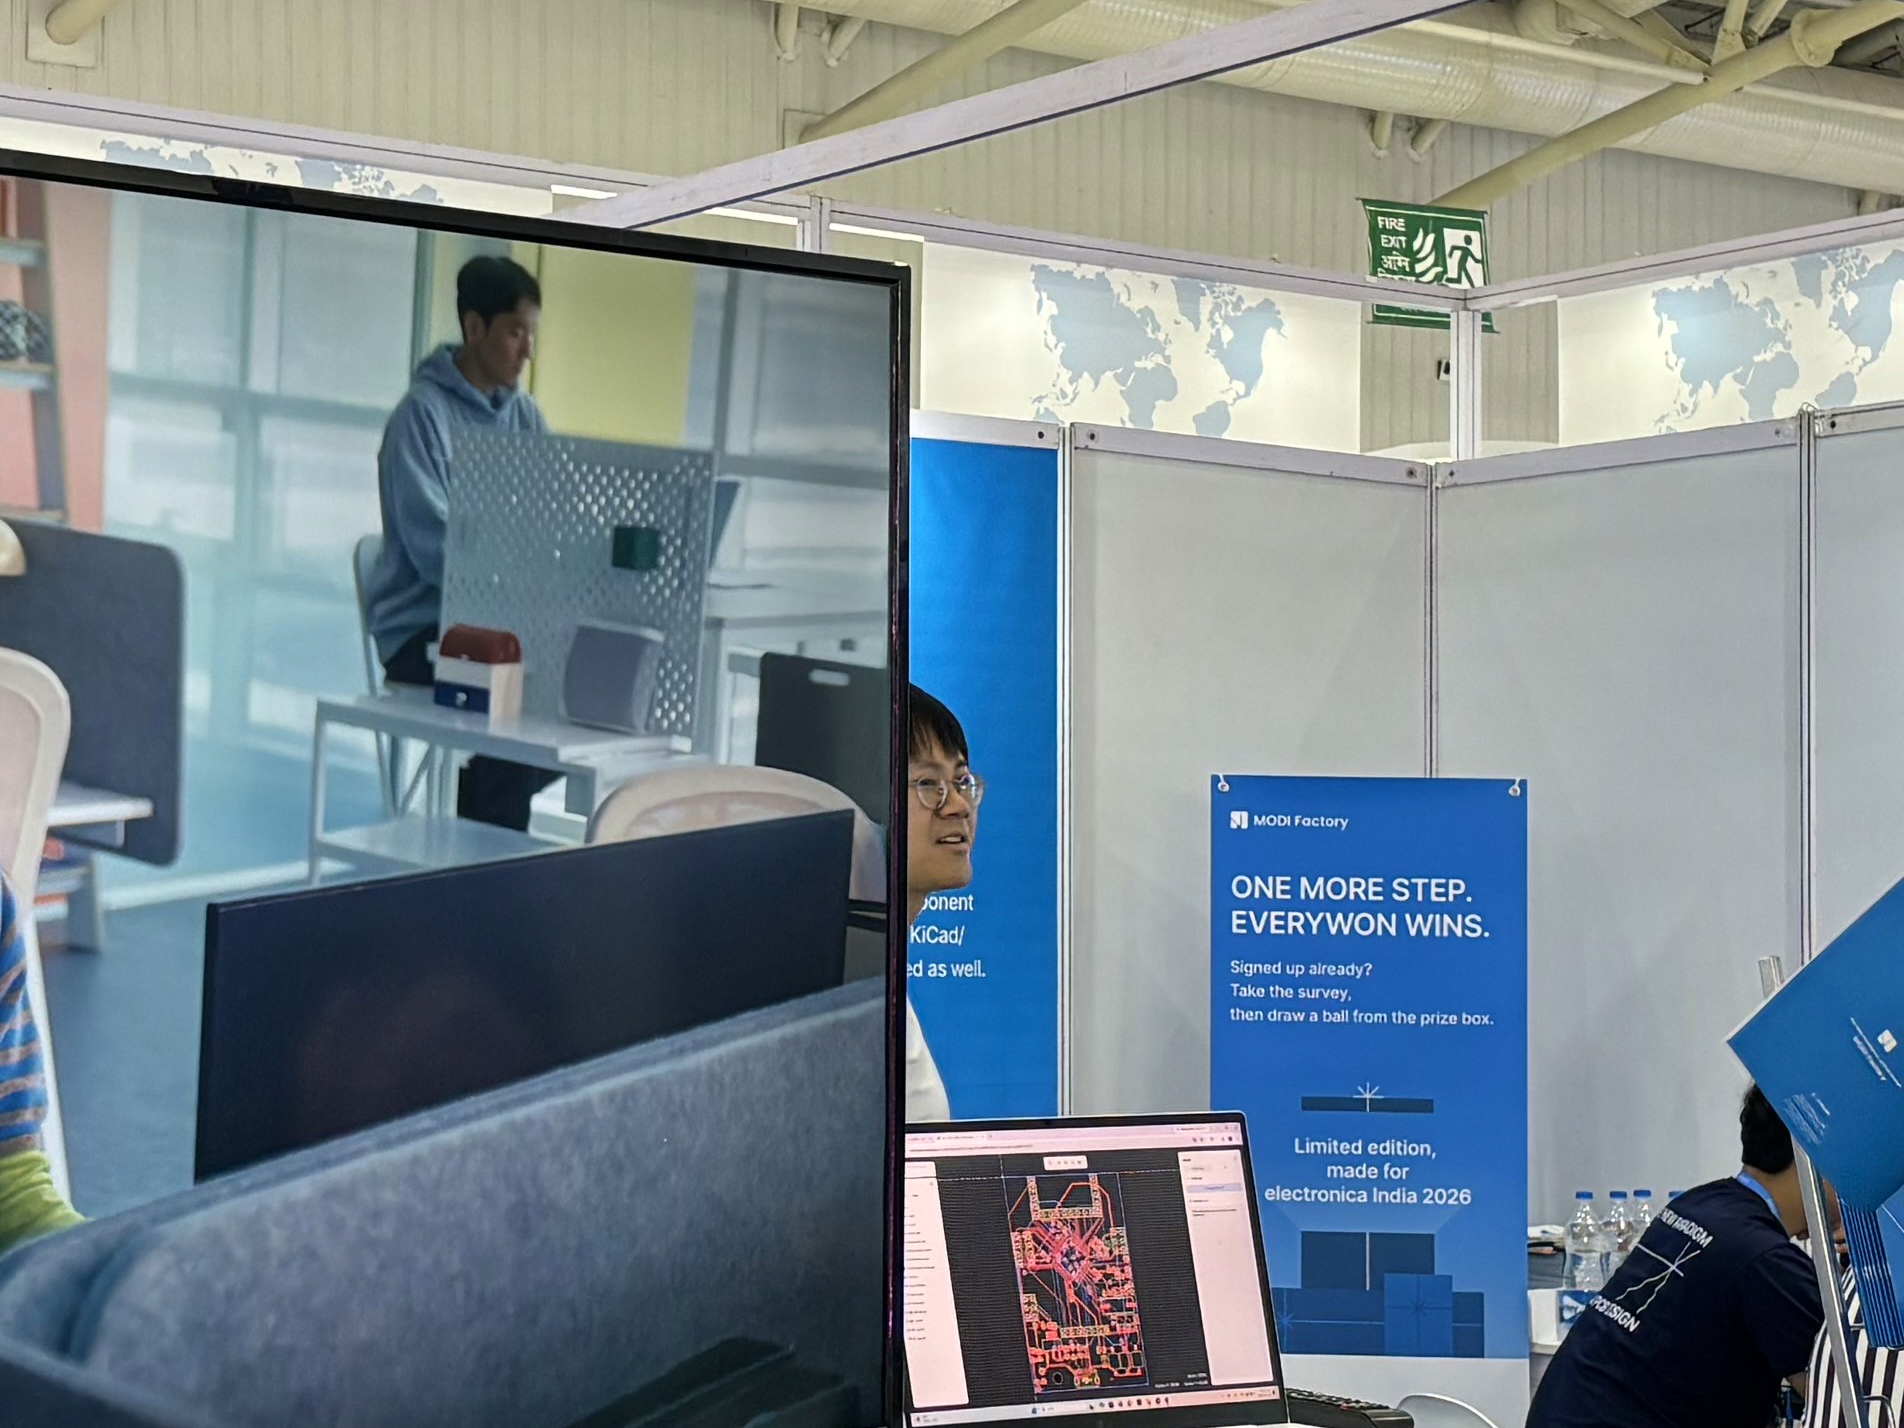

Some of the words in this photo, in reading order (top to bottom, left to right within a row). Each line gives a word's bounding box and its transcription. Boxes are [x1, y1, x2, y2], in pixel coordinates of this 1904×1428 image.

[1377, 216, 1406, 231] FIRE
[1380, 234, 1407, 249] EXIT
[1253, 815, 1291, 827] MODI
[1294, 815, 1349, 831] Factory
[1231, 875, 1291, 900] ONE
[1299, 876, 1384, 901] MORE
[1392, 877, 1473, 903] STEP.
[1231, 910, 1396, 937] EVERYWON
[1404, 913, 1490, 938] WINS.
[909, 925, 965, 946] KiCad/
[927, 963, 947, 977] as
[951, 960, 986, 977] well.
[1230, 960, 1282, 978] Signed
[1286, 963, 1305, 978] up
[1309, 962, 1373, 979] already?
[1230, 984, 1265, 998] Take
[1269, 985, 1294, 998] the
[1298, 987, 1352, 1002] survey,
[1230, 1007, 1264, 1021] then
[1267, 1008, 1306, 1022] draw
[1309, 1012, 1318, 1022] a
[1322, 1009, 1349, 1023] ball
[1352, 1009, 1387, 1024] from
[1392, 1010, 1416, 1024] the
[1420, 1011, 1457, 1027] prize
[1461, 1012, 1495, 1026] box.
[1294, 1138, 1363, 1155] Limited
[1367, 1139, 1437, 1159] edition,
[1326, 1162, 1378, 1179] made
[1383, 1162, 1410, 1179] for
[1264, 1186, 1368, 1203] electronica
[1372, 1187, 1418, 1204] India
[1422, 1188, 1472, 1205] 2026
